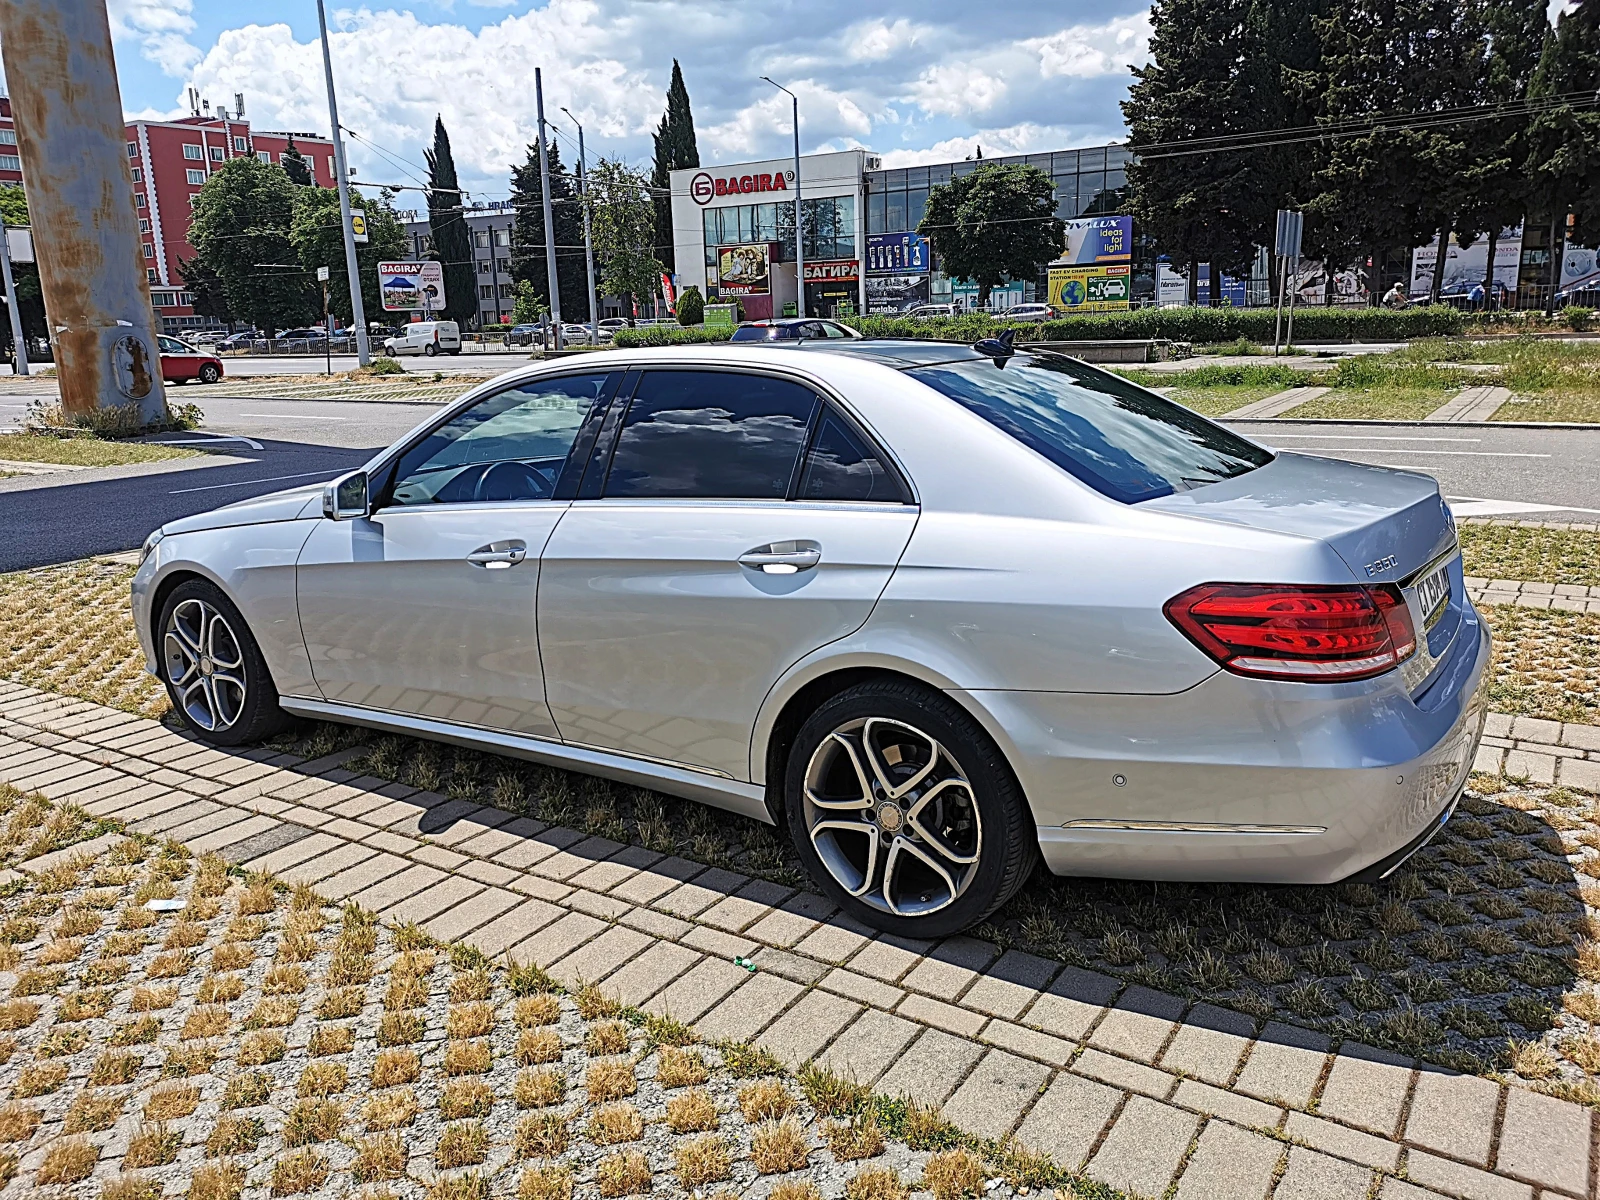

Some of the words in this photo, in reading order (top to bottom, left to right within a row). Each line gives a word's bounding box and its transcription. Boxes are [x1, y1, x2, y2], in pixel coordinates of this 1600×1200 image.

[715, 172, 787, 196] BAGIRA
[1068, 219, 1121, 230] IVALUX
[1111, 236, 1123, 244] for
[1104, 243, 1123, 253] light
[380, 265, 418, 273] BAGIRA
[803, 264, 860, 278] БАГИРА
[720, 287, 750, 295] BAGIRA
[868, 305, 898, 313] metabo
